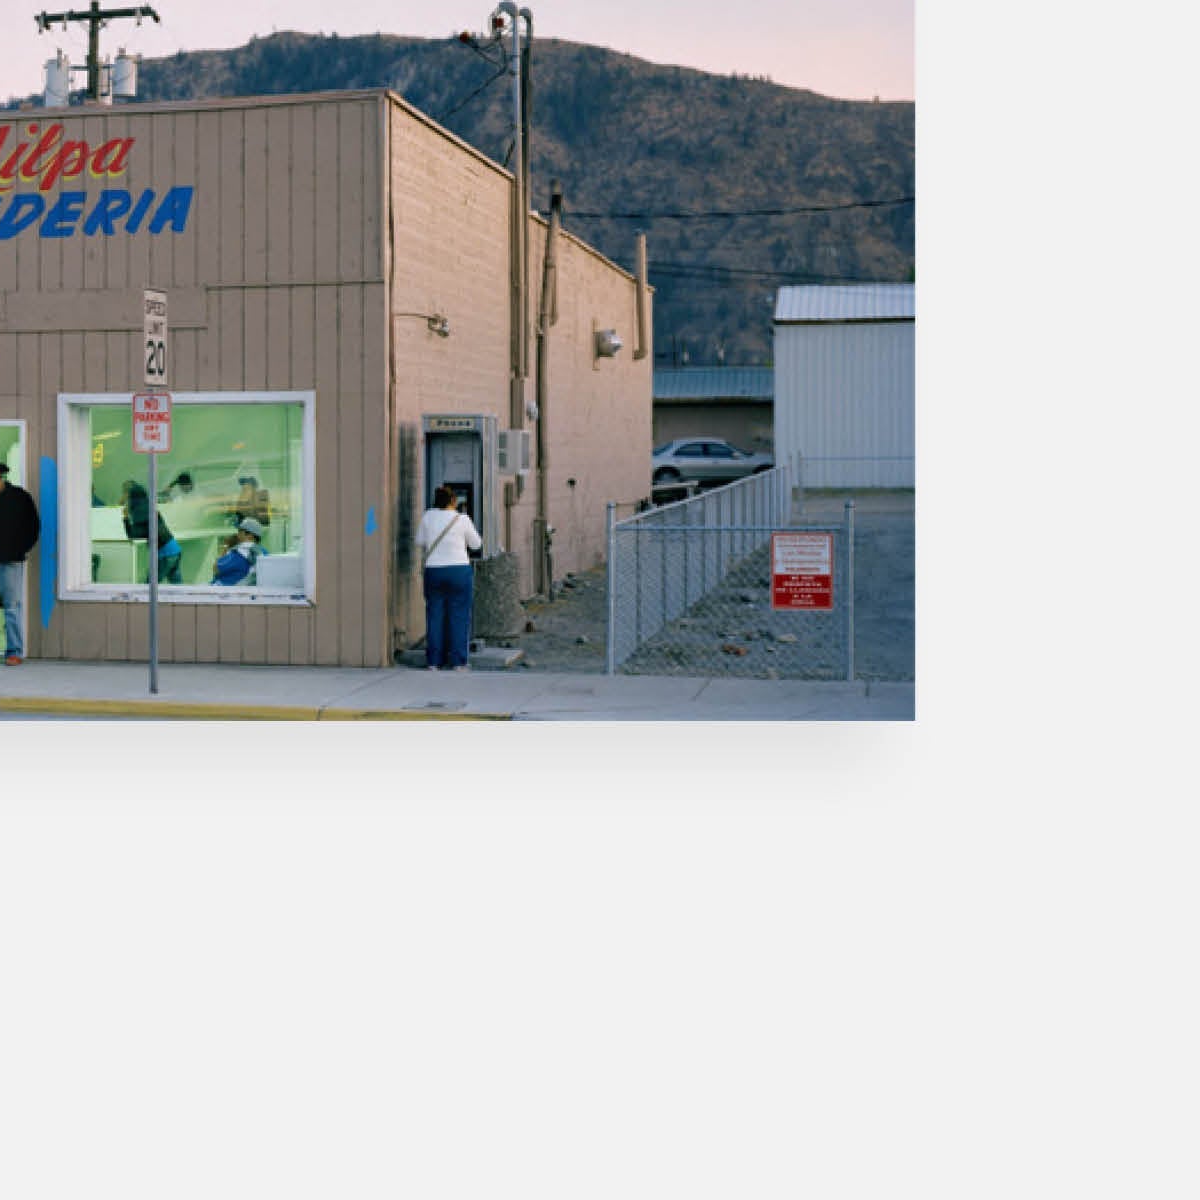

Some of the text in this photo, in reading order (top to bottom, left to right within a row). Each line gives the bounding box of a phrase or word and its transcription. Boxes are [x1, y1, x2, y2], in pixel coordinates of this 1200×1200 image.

[146, 340, 165, 376] 20
[144, 399, 158, 410] NO
[134, 411, 170, 422] PARKING
